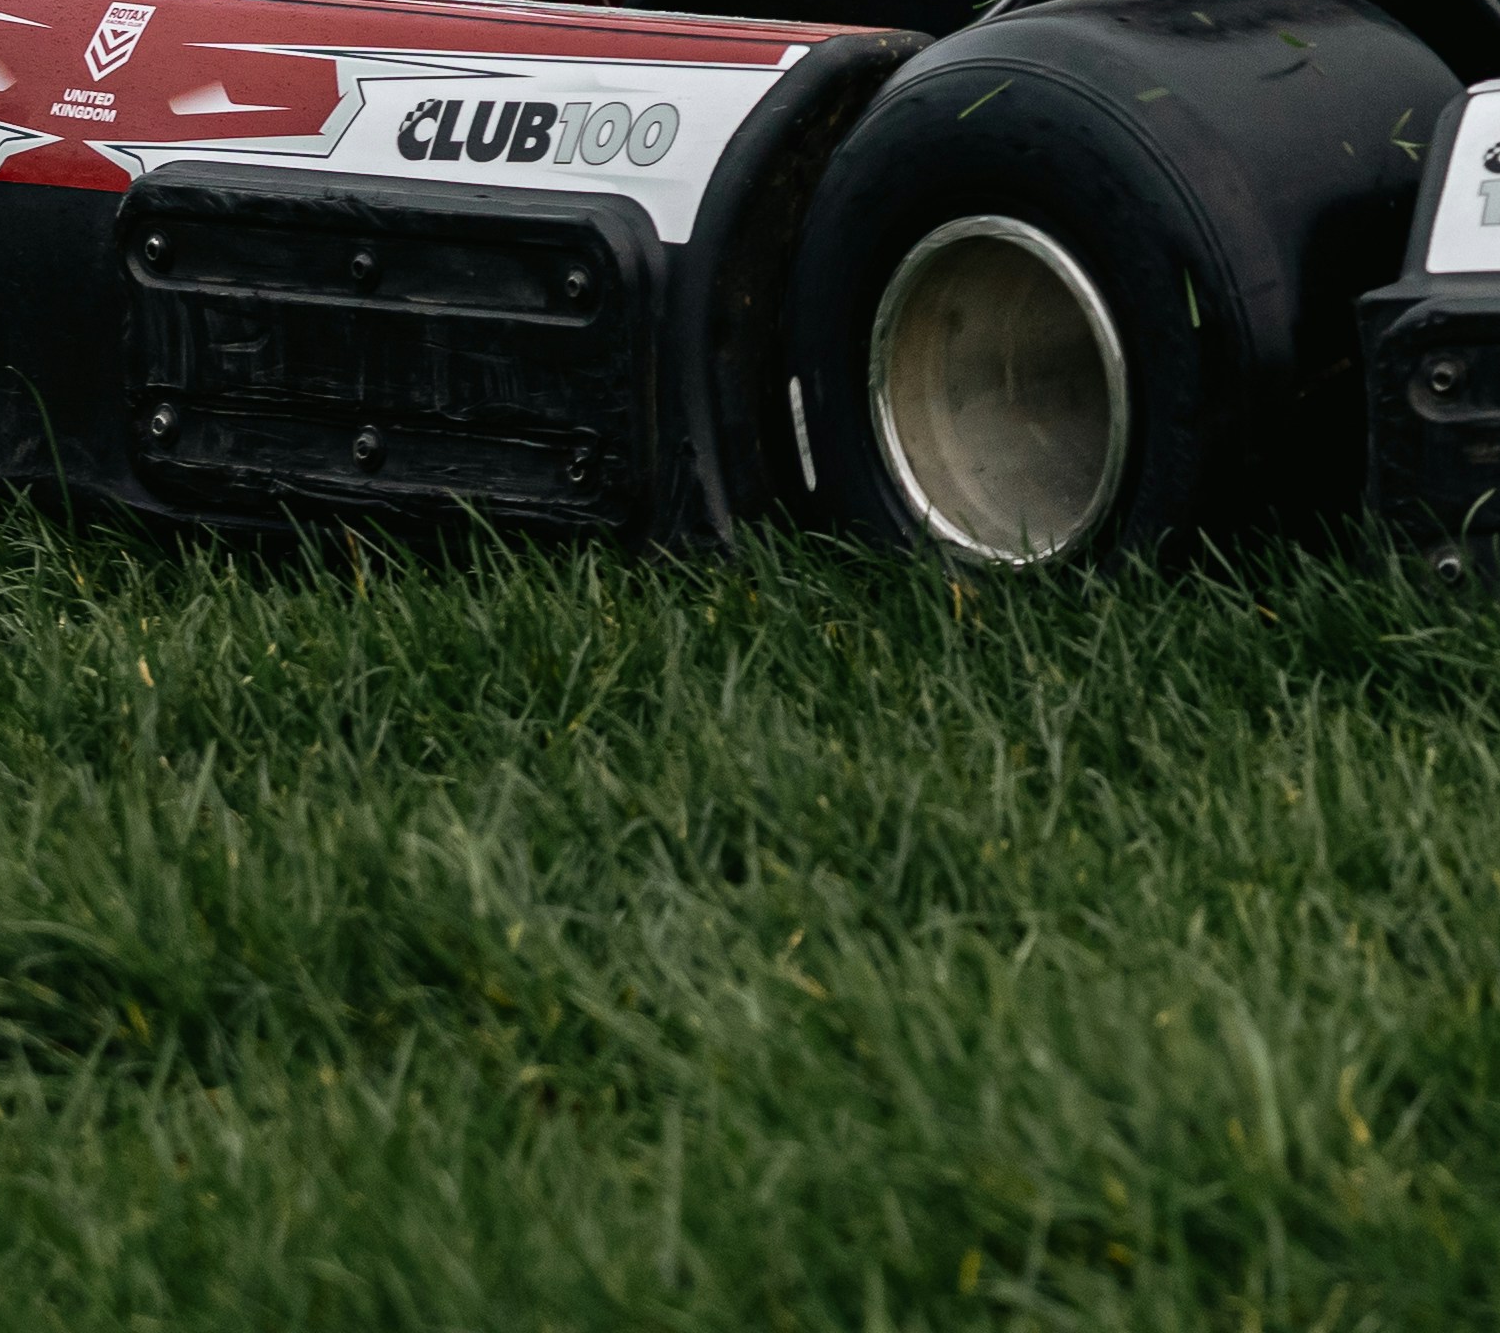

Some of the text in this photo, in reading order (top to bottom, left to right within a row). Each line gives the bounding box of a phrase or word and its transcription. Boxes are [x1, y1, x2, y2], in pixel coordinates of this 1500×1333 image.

[109, 7, 149, 22] ROTAX
[63, 88, 116, 107] UNITED
[50, 102, 118, 123] KINGDOM
